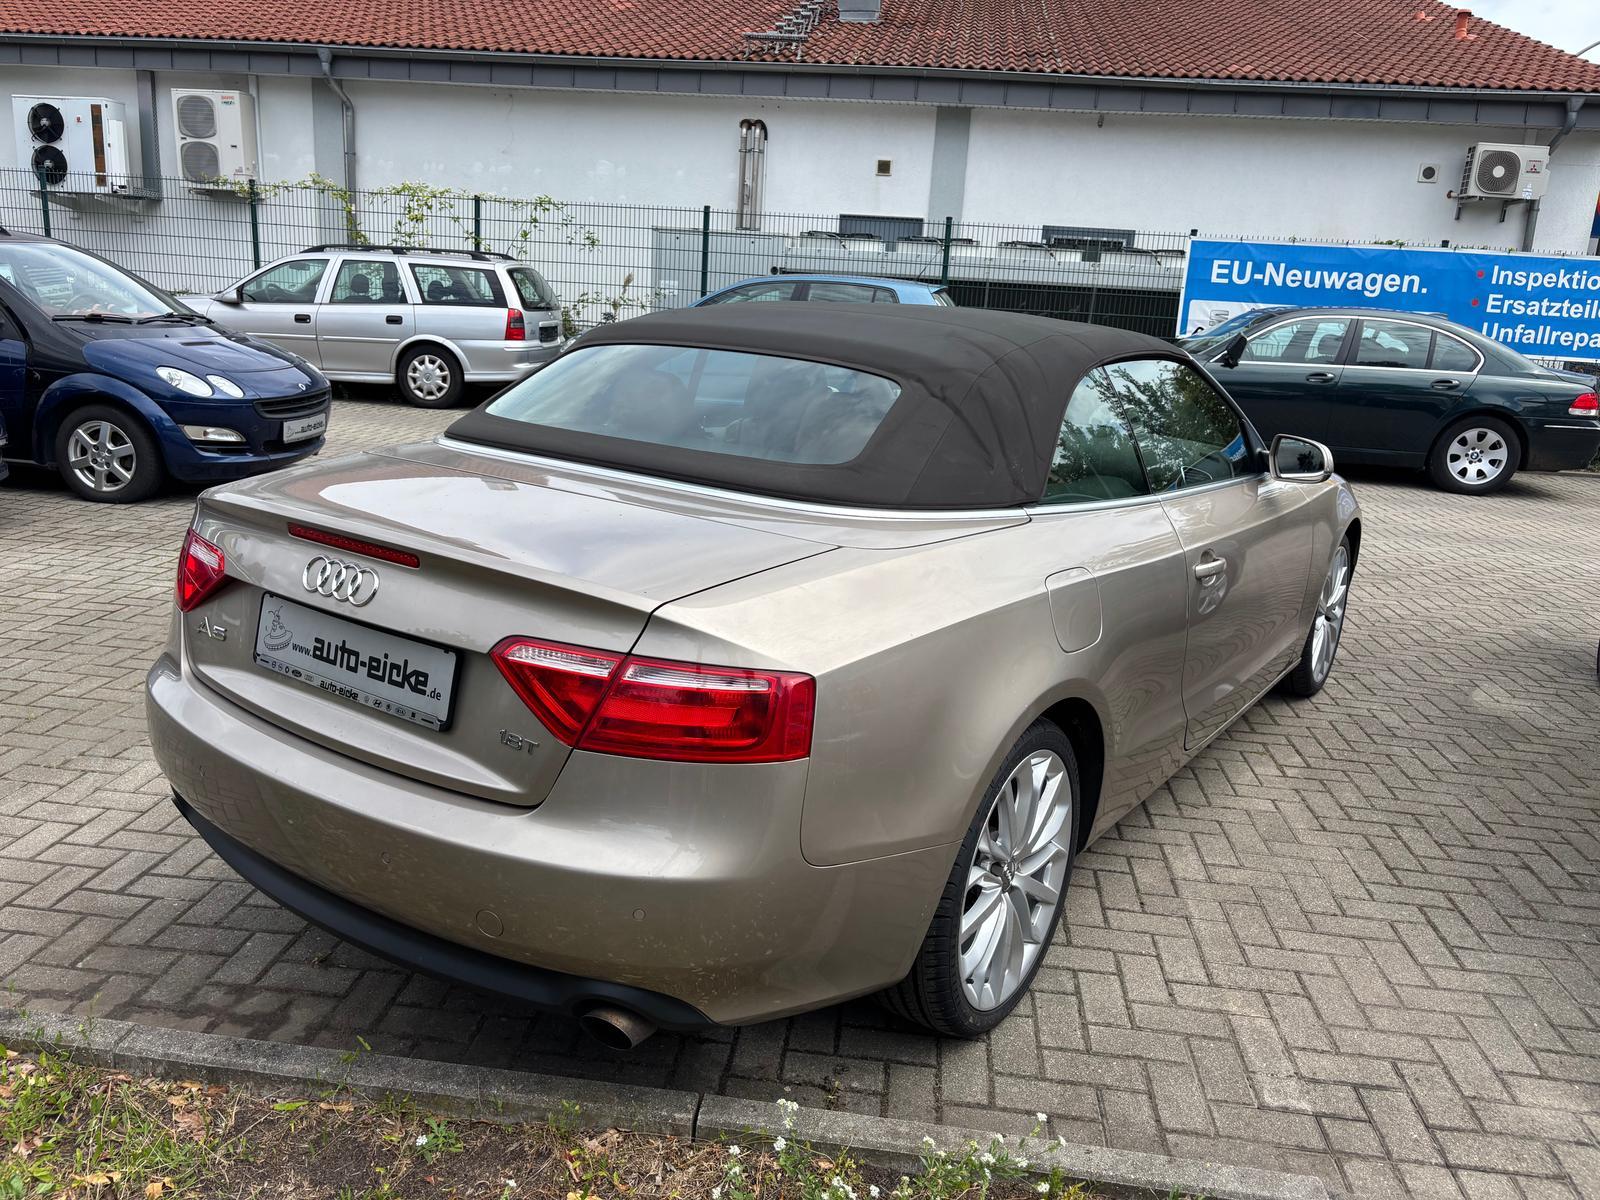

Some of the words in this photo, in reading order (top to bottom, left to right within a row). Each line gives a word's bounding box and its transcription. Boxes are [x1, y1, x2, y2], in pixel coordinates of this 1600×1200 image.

[1210, 259, 1429, 297] EU-Neuwagen.
[1486, 293, 1600, 319] Ersatzteil
[197, 616, 228, 642] A5
[291, 636, 442, 702] www.auto-eicke.de
[319, 679, 359, 701] auto-eicke
